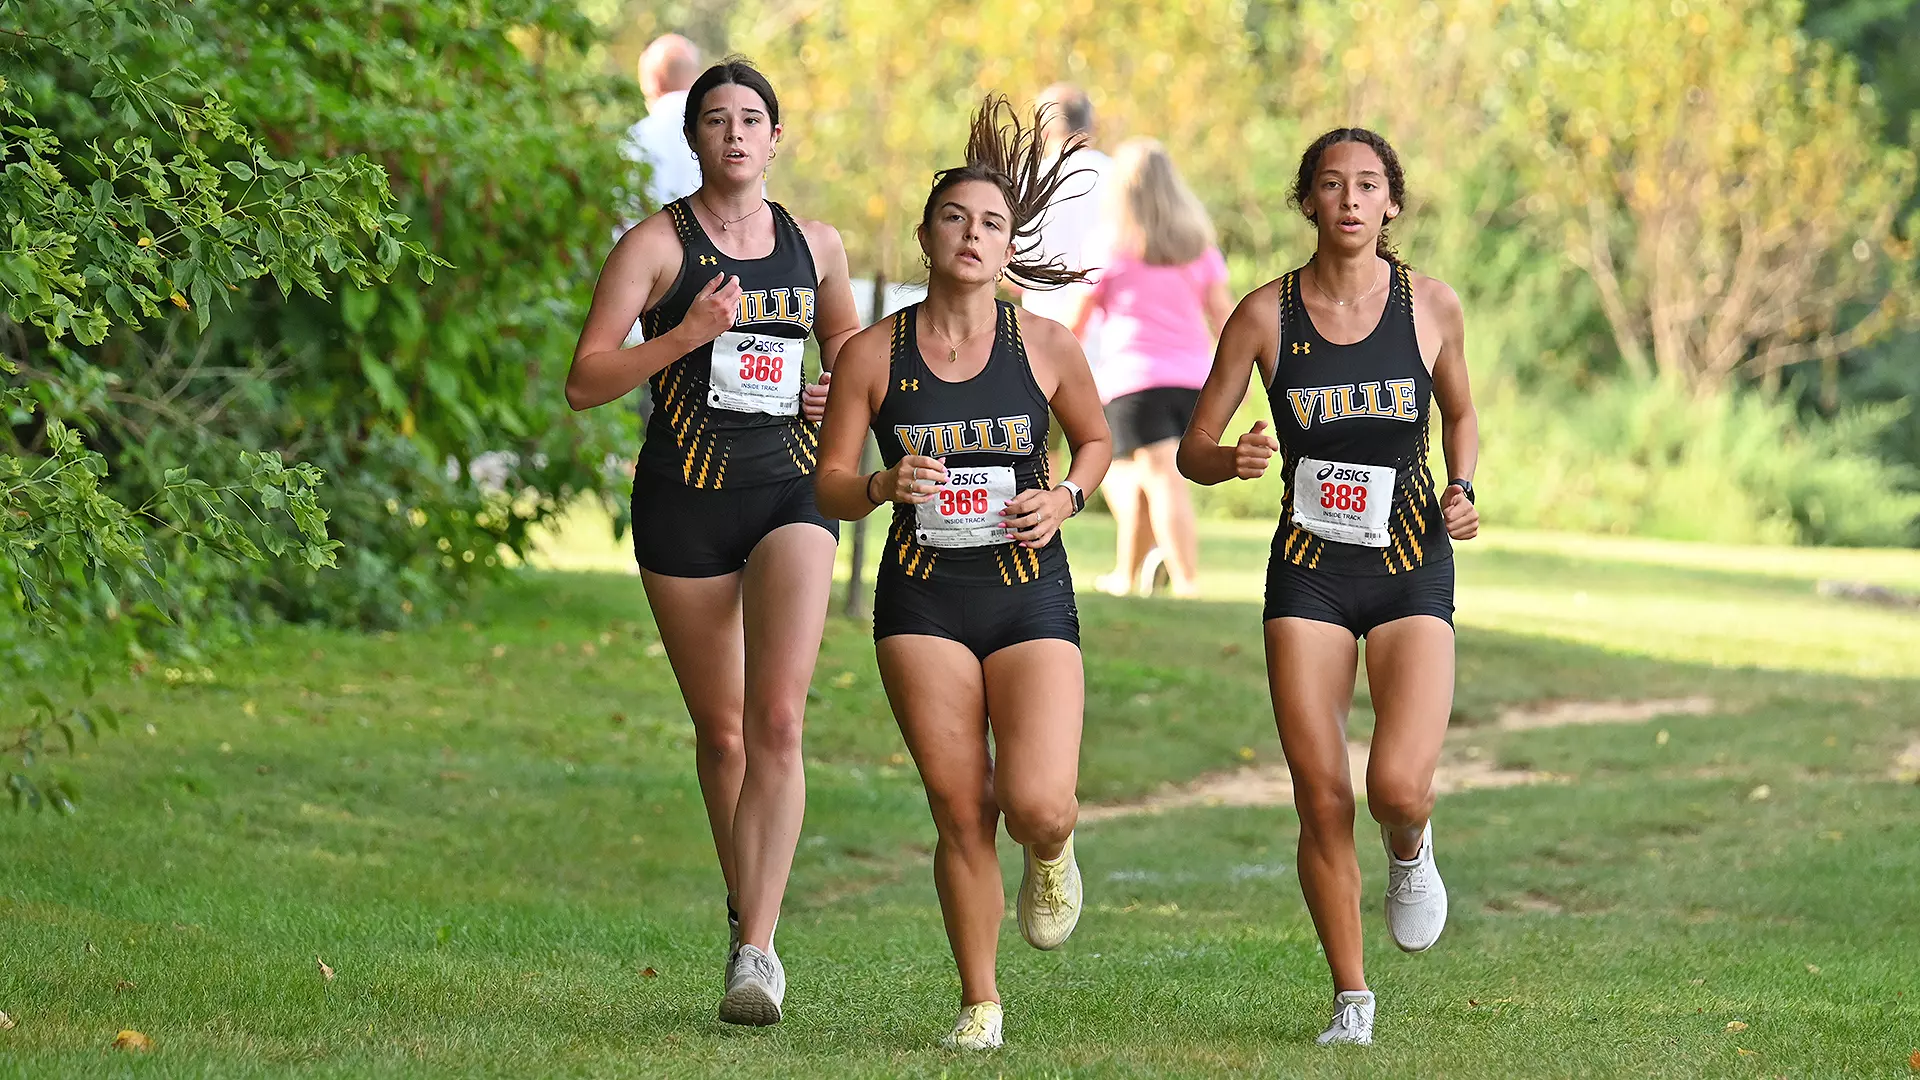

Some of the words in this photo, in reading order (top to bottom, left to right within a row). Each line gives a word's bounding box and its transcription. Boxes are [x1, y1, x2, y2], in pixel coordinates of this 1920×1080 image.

[736, 287, 815, 333] ILLE
[739, 354, 784, 384] 368
[741, 383, 759, 391] INSIDE
[761, 384, 779, 392] TRACK
[1286, 378, 1419, 430] VILLE
[894, 414, 1034, 457] VILLE
[939, 488, 988, 516] 366
[1320, 482, 1368, 513] 383
[1322, 511, 1341, 519] INSIDE
[1343, 512, 1362, 521] TRACK
